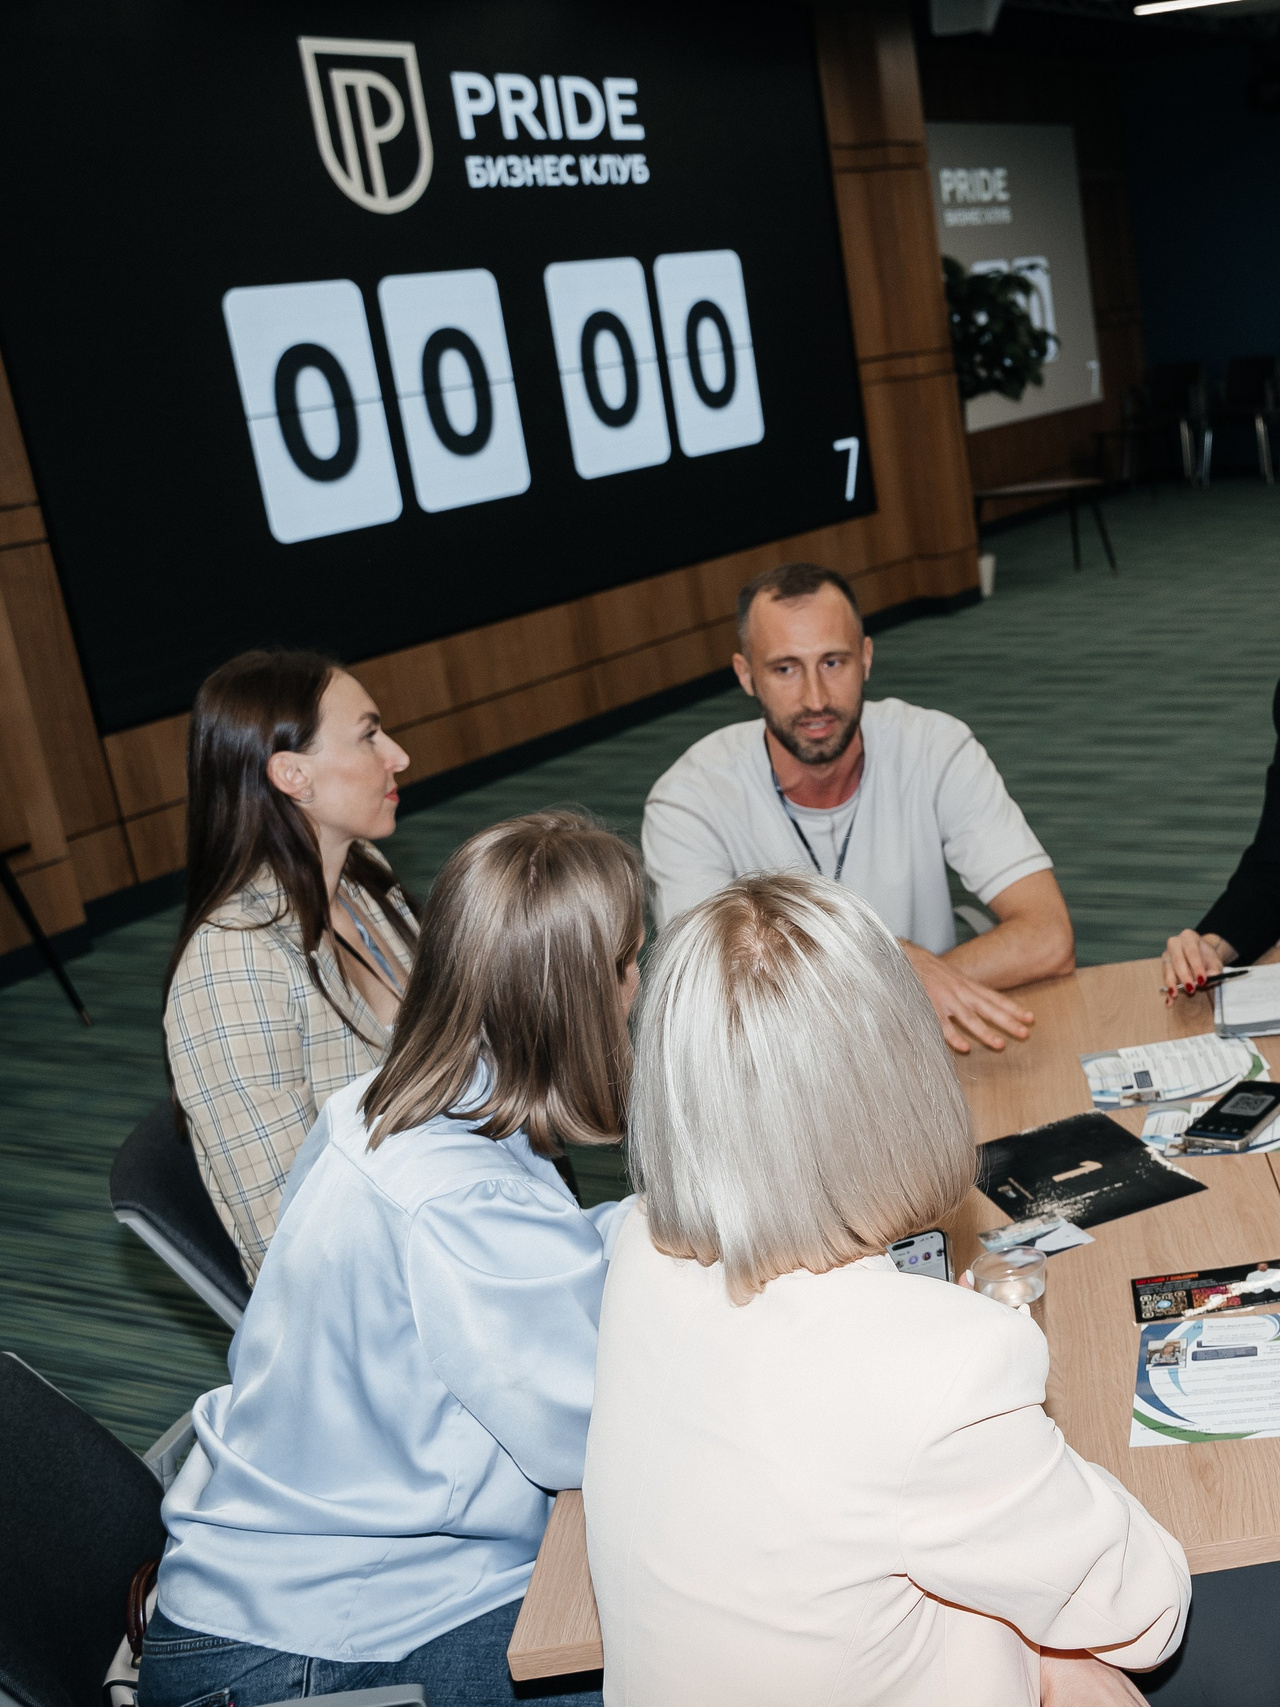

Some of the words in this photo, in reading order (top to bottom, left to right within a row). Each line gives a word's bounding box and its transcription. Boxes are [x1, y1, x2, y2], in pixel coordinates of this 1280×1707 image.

[451, 72, 647, 142] PRIDE
[465, 155, 579, 190] БИЗНЕС
[579, 154, 651, 187] КЛУБ
[940, 168, 1011, 204] PRIDE
[834, 437, 861, 502] 7
